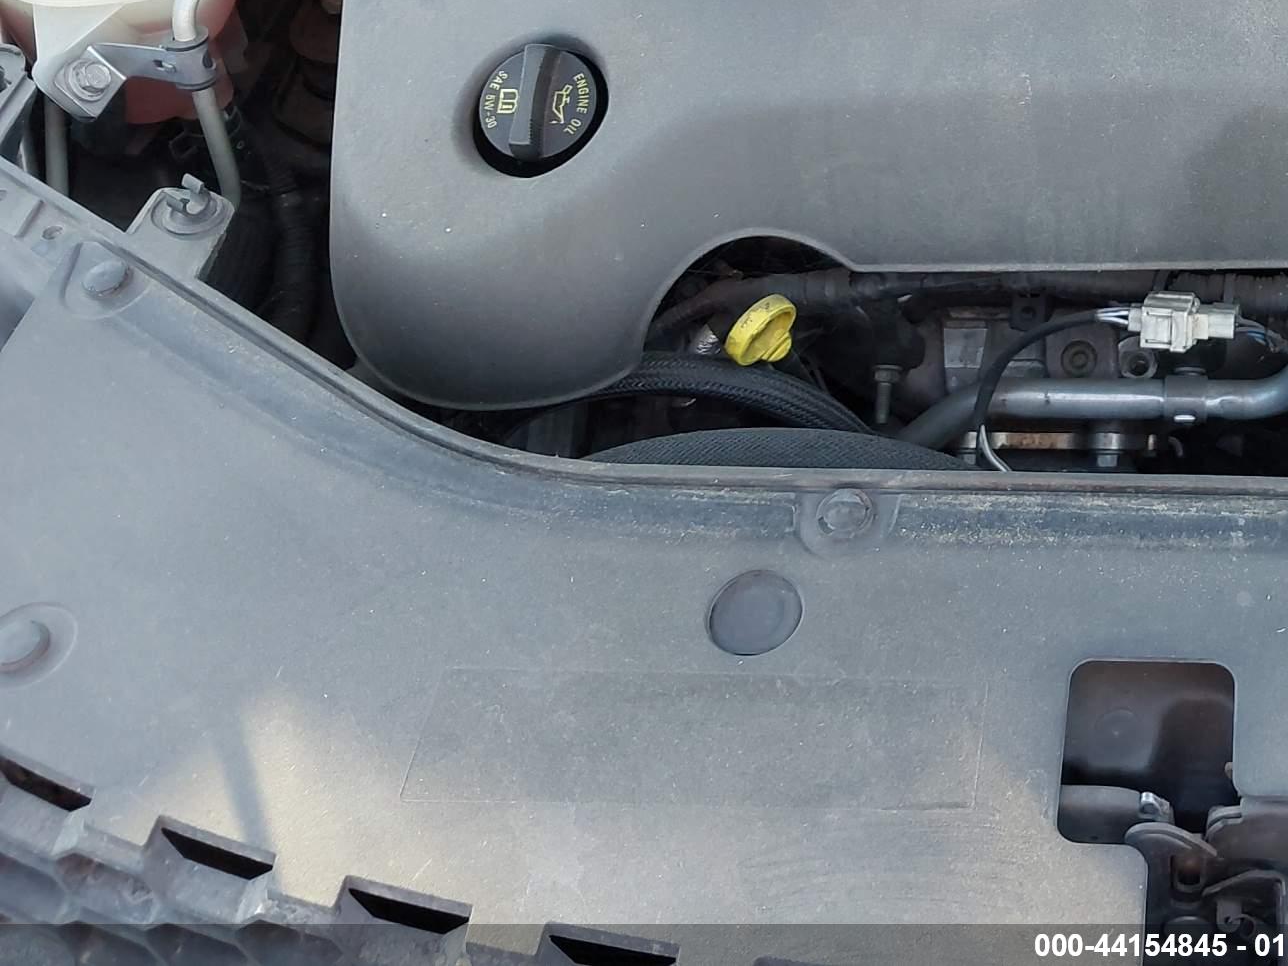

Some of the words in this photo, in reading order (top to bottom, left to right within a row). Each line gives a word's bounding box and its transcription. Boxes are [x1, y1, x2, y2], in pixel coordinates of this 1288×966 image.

[489, 70, 508, 90] SAE
[573, 72, 590, 114] ENGINE
[484, 94, 498, 129] 5W-30
[563, 118, 582, 135] OIL
